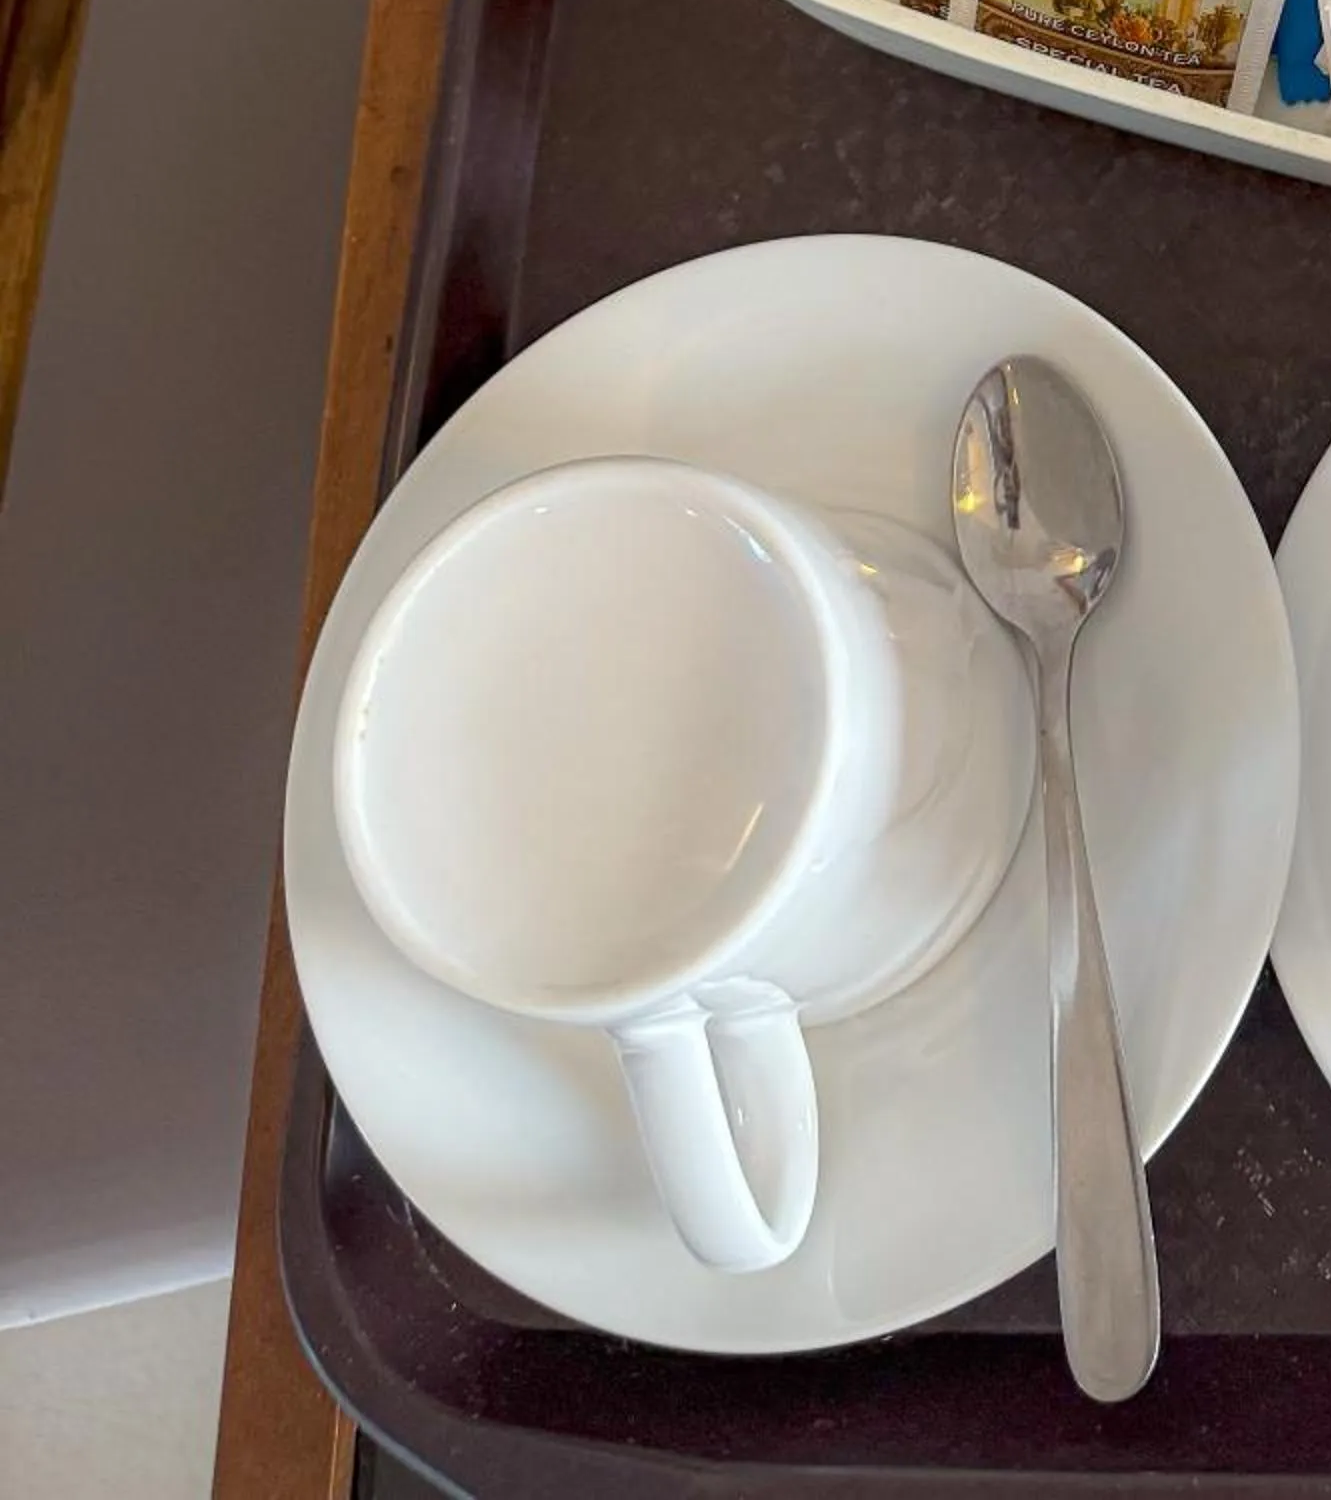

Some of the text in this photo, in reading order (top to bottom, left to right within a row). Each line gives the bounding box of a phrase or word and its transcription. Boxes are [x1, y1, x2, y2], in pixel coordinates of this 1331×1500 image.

[1011, 0, 1201, 65] PURE CEYLON TEA
